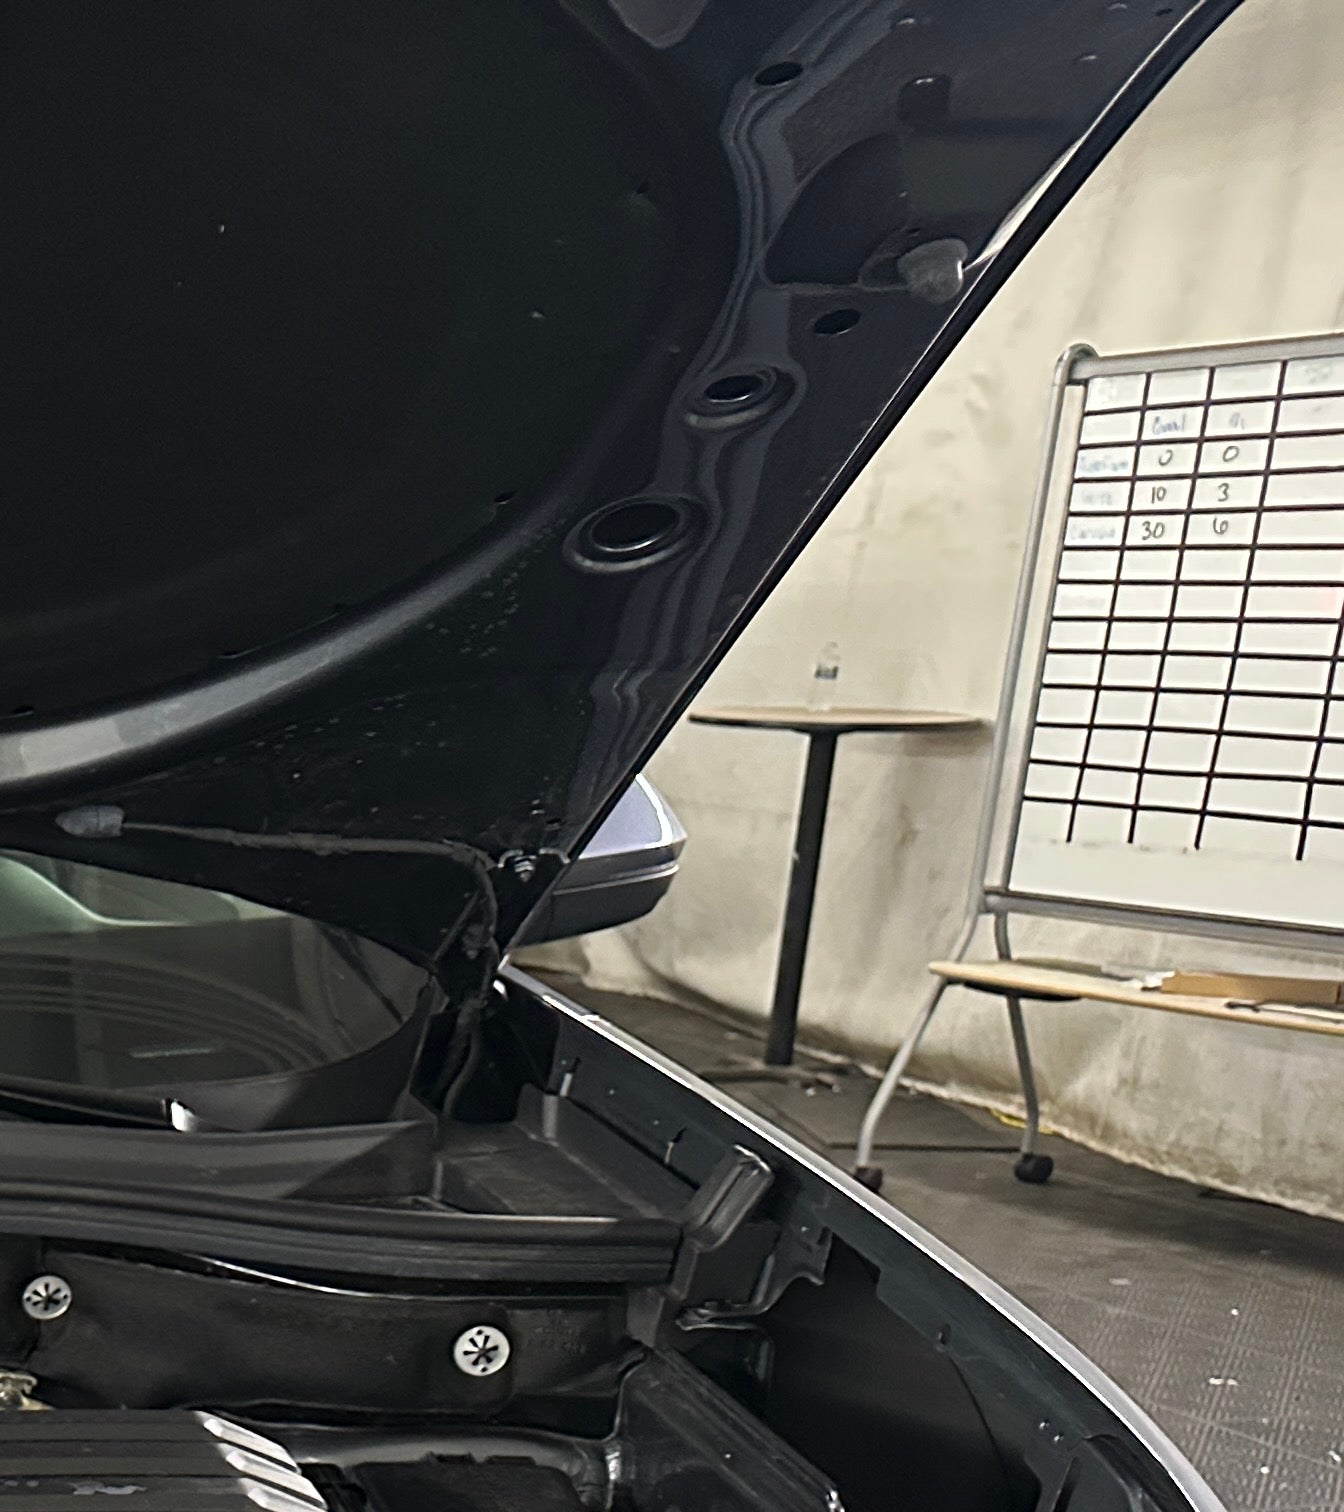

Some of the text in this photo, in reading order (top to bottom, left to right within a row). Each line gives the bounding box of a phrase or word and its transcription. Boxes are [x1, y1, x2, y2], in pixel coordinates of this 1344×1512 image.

[1222, 445, 1239, 463] 0
[1150, 482, 1230, 504] 10 3
[1141, 517, 1229, 540] 30 6
